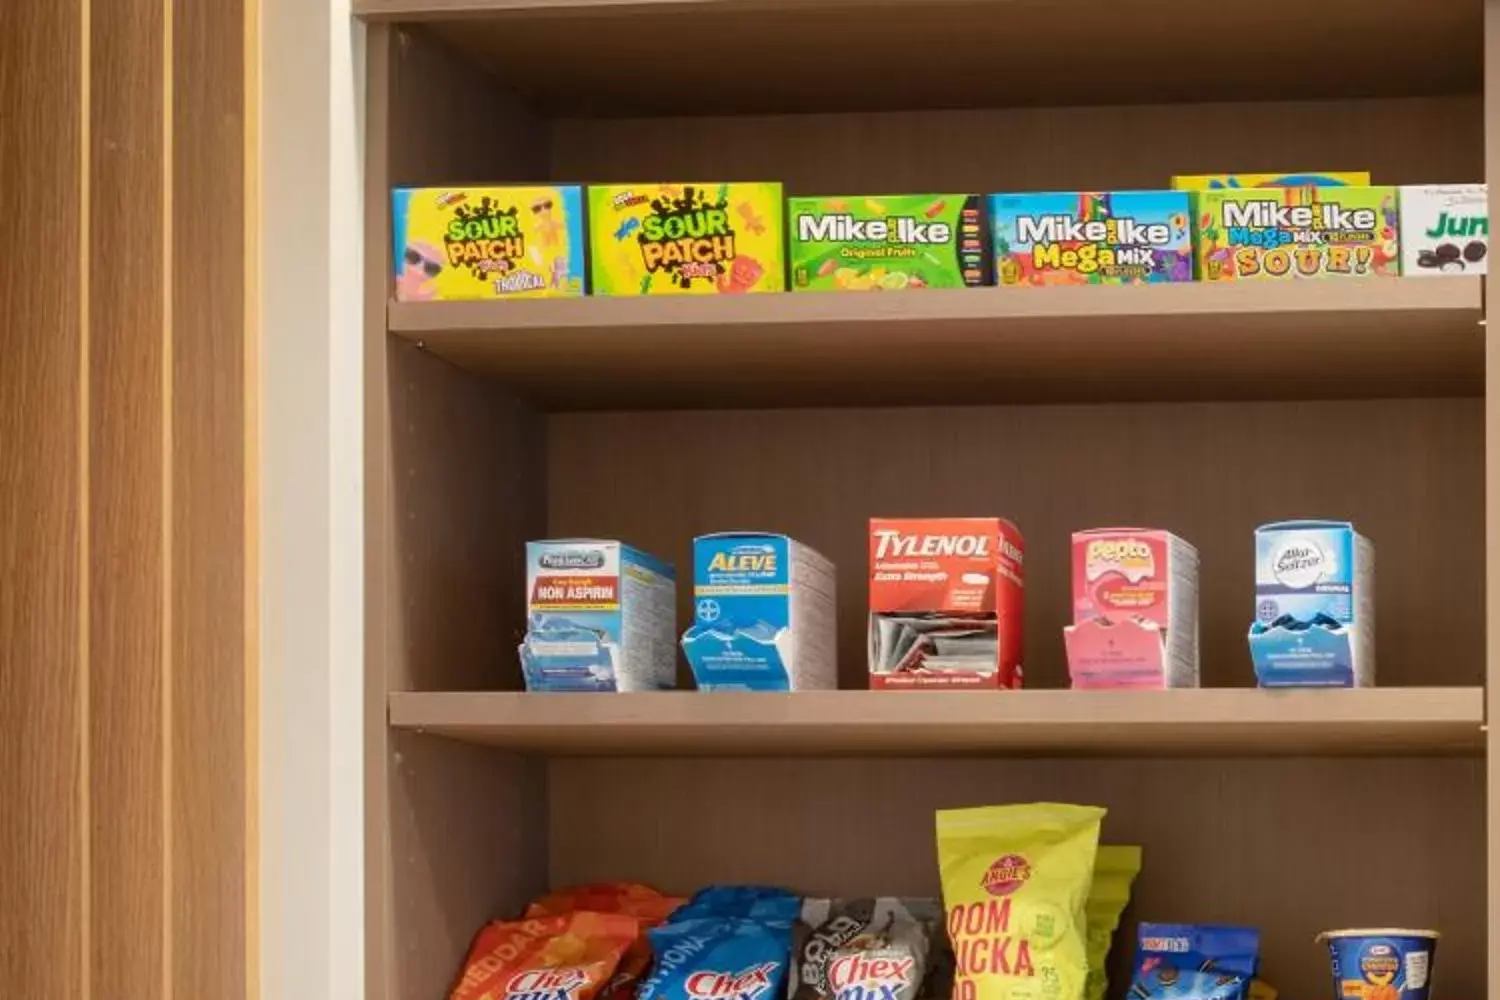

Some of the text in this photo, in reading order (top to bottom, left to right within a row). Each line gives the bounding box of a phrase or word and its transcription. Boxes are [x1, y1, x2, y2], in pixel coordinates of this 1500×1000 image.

[448, 216, 518, 242] SOUR
[642, 210, 727, 240] SOUR
[799, 215, 887, 242] Mike
[899, 218, 951, 244] Ike
[1016, 215, 1106, 242] Mike
[1117, 219, 1170, 244] Ike
[1222, 201, 1313, 228] Mike
[1324, 203, 1376, 230] Ike
[447, 239, 524, 263] PATCH
[641, 238, 735, 267] PATCH
[841, 247, 916, 259] Original Fruits
[1228, 228, 1292, 249] Mega
[1033, 243, 1115, 273] Mega
[1117, 248, 1155, 267] Mix
[1236, 248, 1371, 277] SOUR!
[873, 529, 990, 559] TYLENOL
[708, 551, 777, 572] ALEVE
[537, 586, 613, 599] NON ASPIRIN
[505, 966, 588, 993] Chex
[685, 961, 780, 996] Chex
[829, 954, 914, 991] Chex
